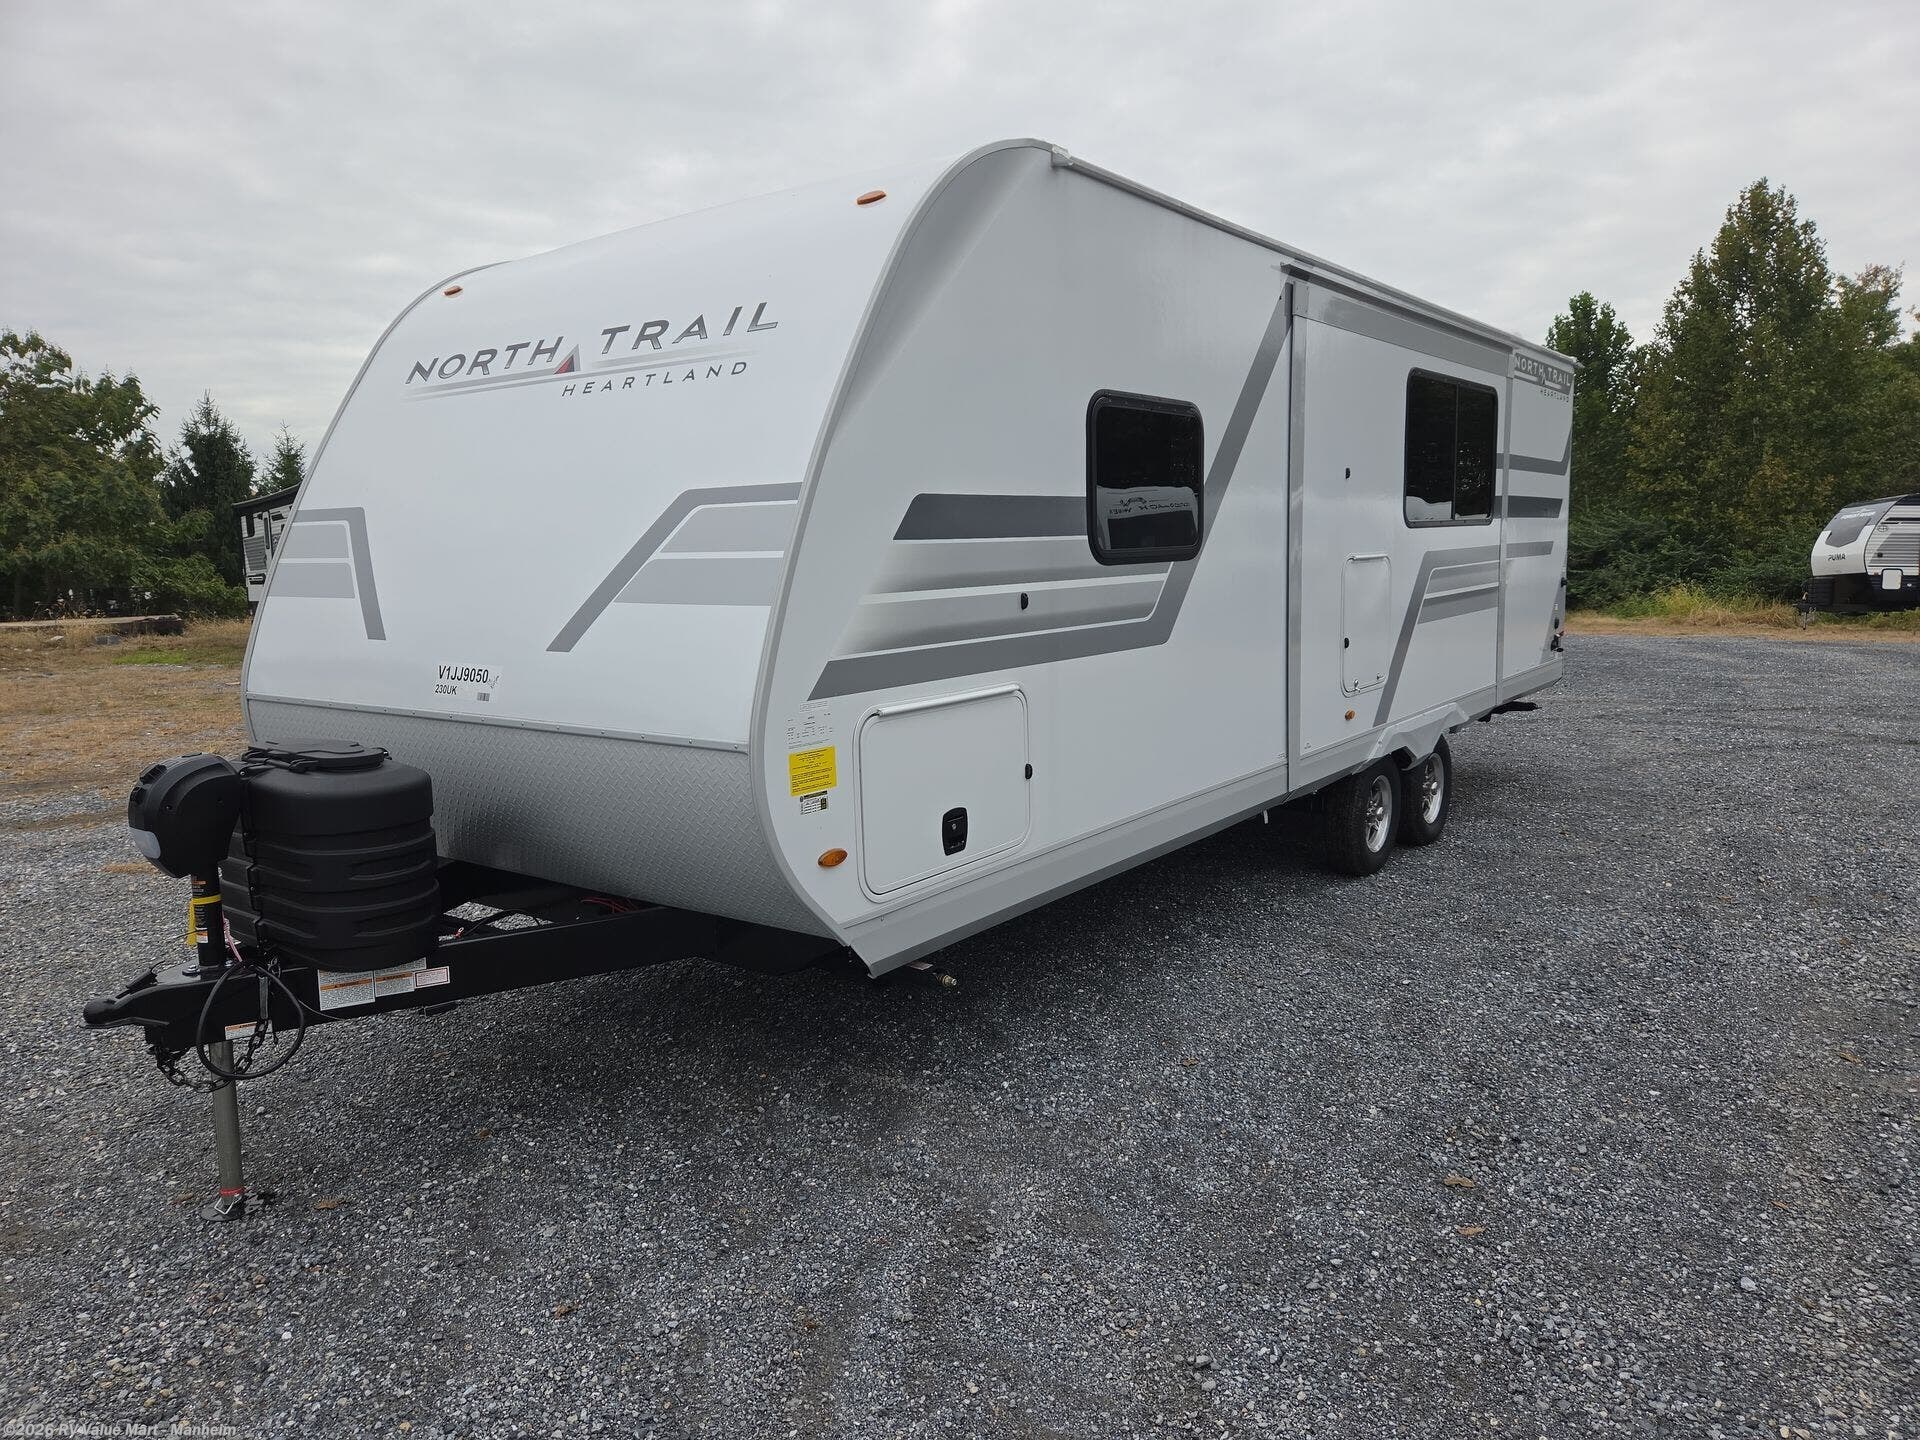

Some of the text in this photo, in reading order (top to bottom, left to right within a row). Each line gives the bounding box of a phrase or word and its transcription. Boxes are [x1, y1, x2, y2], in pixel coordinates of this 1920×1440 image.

[405, 302, 779, 385] NORTH TRAIL
[562, 361, 748, 397] HEARTLAND
[1514, 355, 1571, 387] NORTH TRAIL
[1828, 553, 1846, 561] PUMA
[438, 665, 489, 683] V1JJ9050
[435, 684, 457, 695] 230UK
